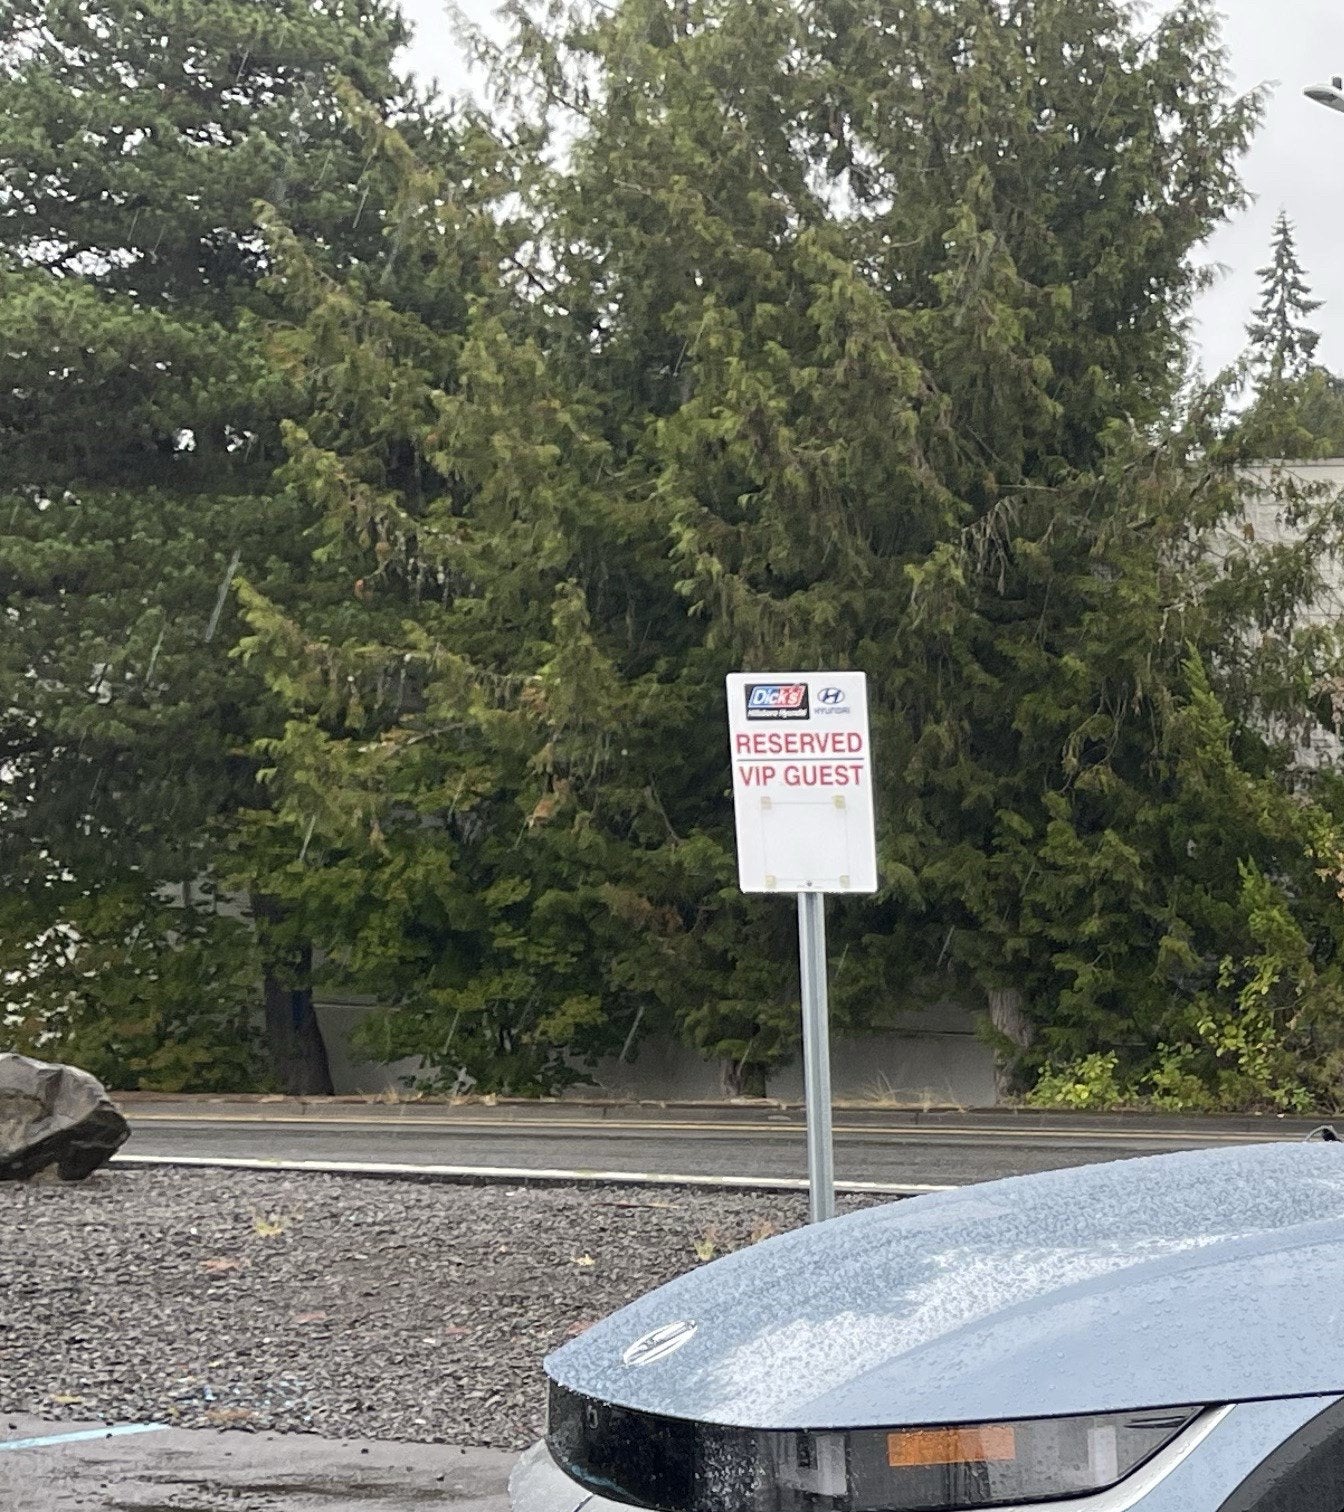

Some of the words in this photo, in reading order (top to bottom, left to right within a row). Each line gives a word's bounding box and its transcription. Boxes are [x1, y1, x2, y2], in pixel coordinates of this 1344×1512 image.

[736, 732, 864, 754] RESERVED
[739, 766, 776, 786] VIP
[784, 765, 864, 785] GUEST
